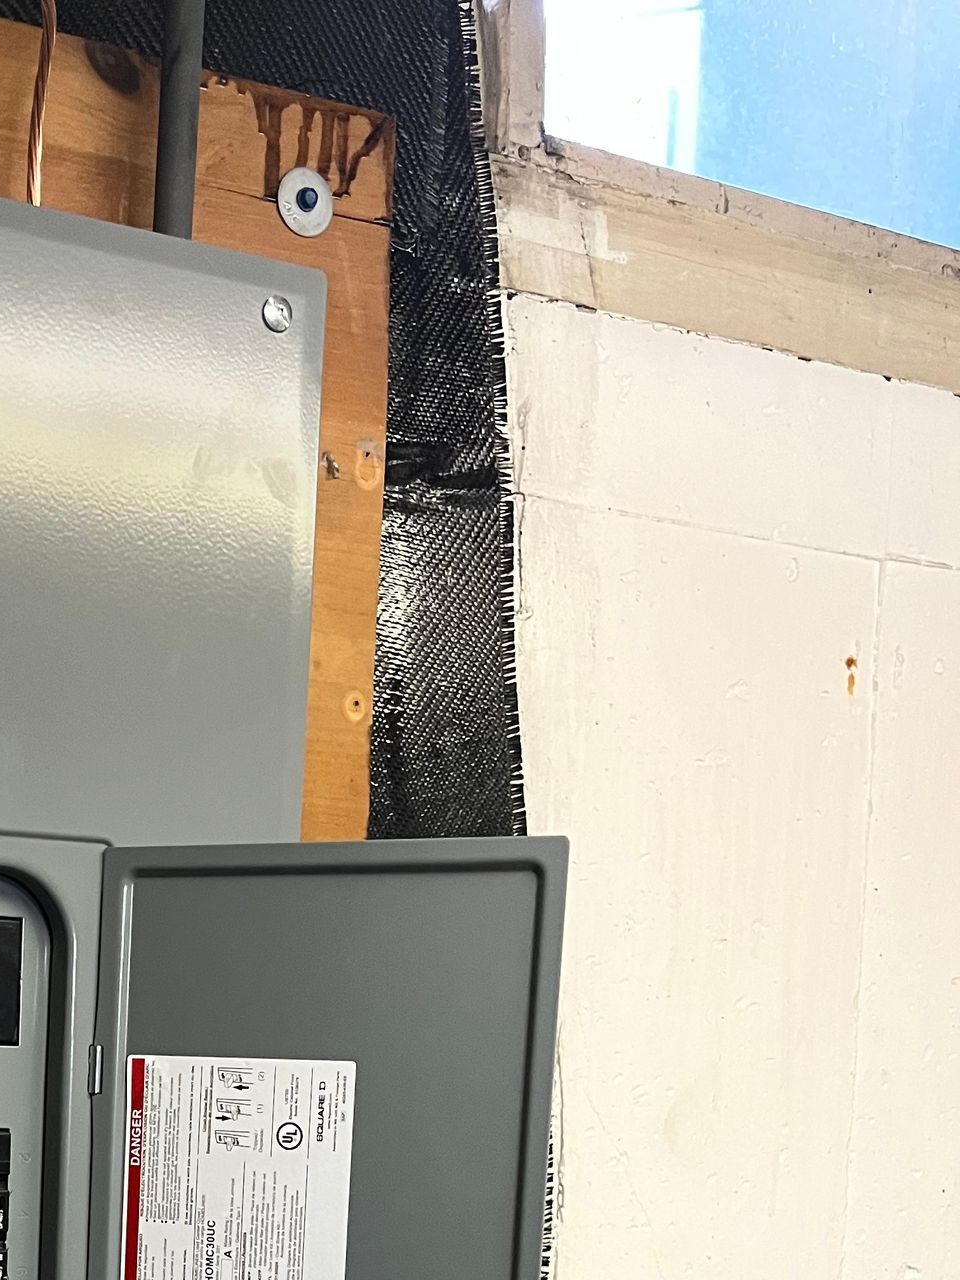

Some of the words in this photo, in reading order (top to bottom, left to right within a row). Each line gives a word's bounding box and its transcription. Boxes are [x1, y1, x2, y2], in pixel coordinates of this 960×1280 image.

[319, 1081, 326, 1090] D
[316, 1095, 325, 1142] SQUARE
[131, 1109, 142, 1165] DANGER
[224, 1250, 232, 1258] A
